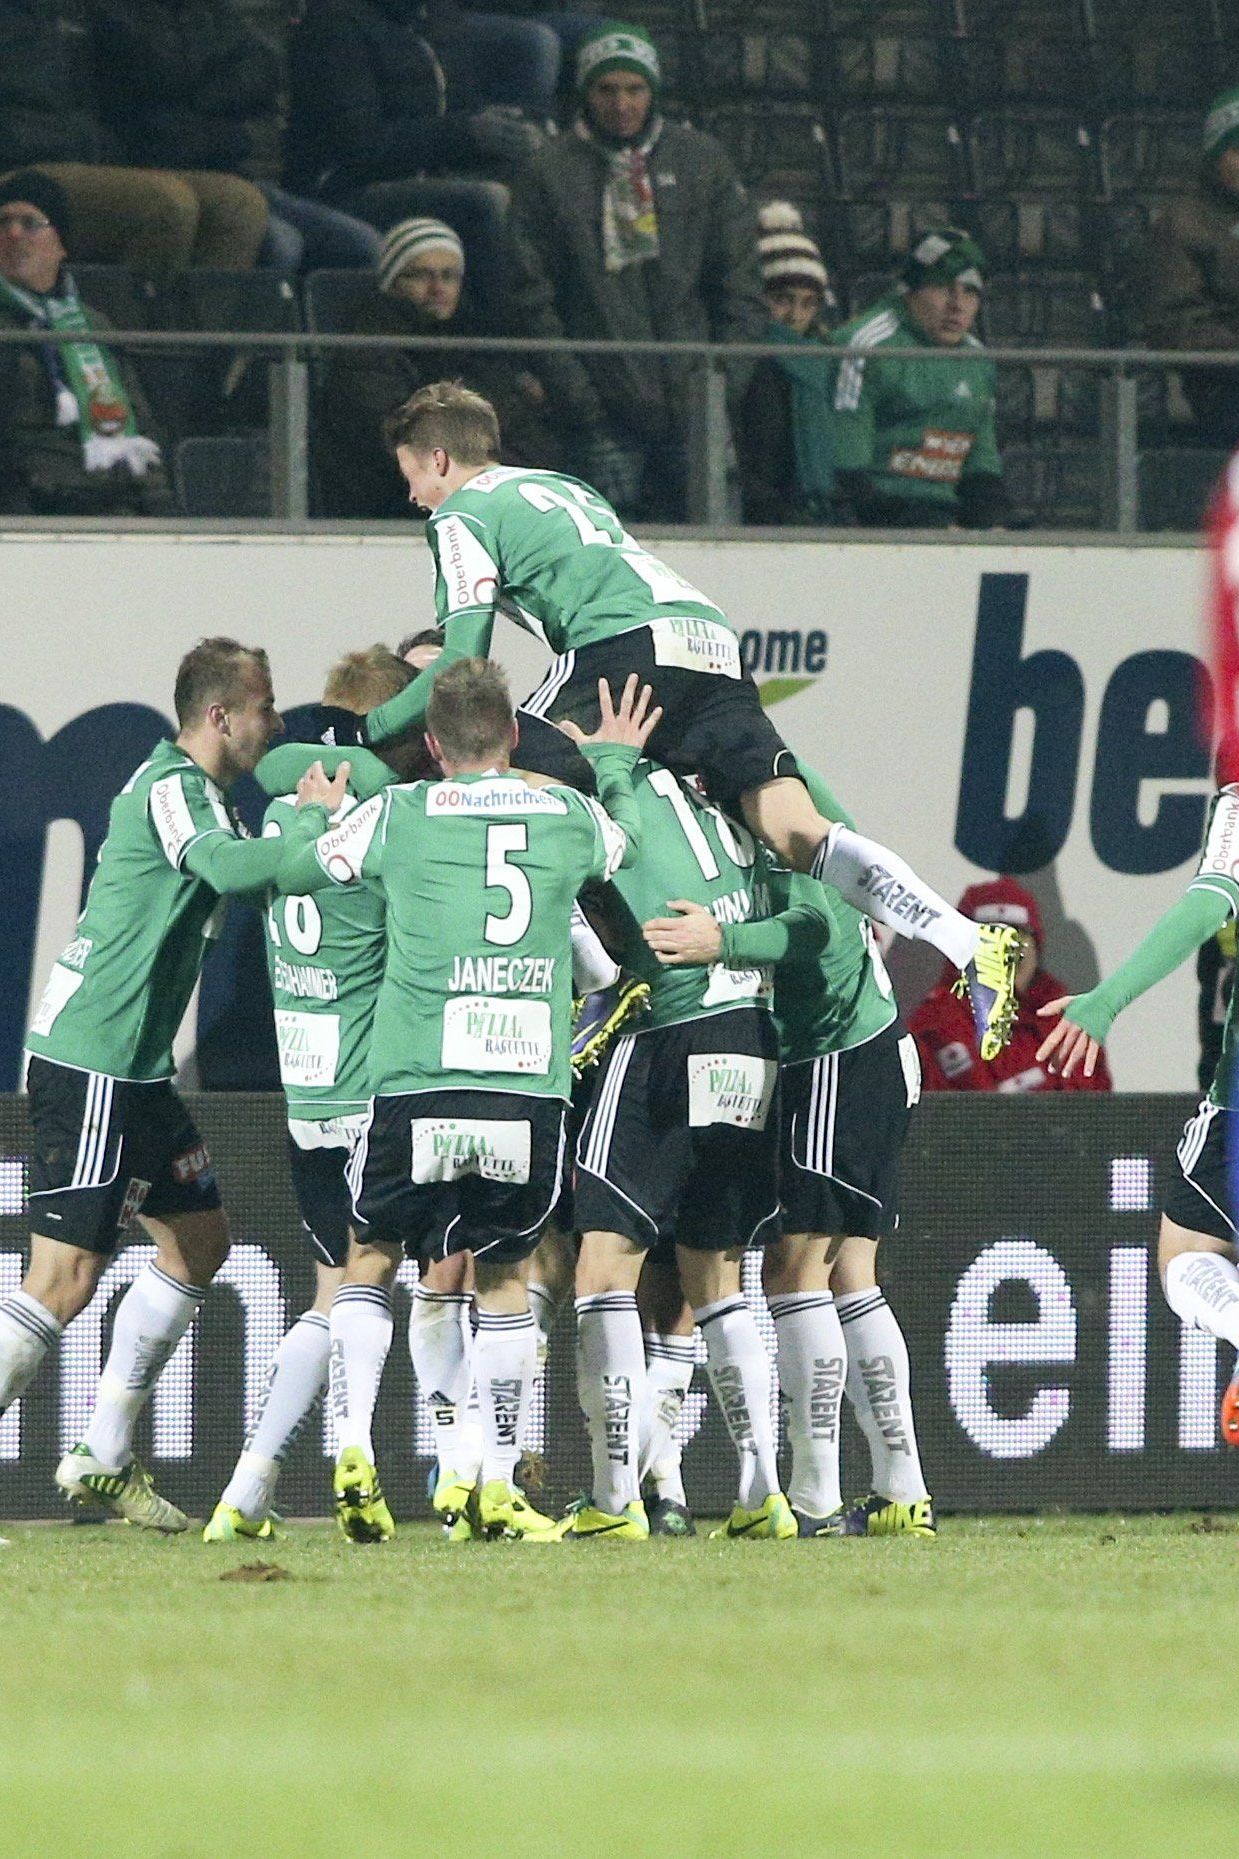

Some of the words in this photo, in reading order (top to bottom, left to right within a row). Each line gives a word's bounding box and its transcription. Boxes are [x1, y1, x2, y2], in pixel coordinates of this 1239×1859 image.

[447, 524, 471, 605] Oberbank
[953, 573, 1216, 875] be
[156, 784, 184, 848] Oberbank
[320, 802, 378, 857] Oberbank
[1213, 802, 1239, 871] Oberbank
[484, 822, 533, 946] 5
[447, 956, 556, 997] JANECZEK
[435, 1408, 456, 1427] 5
[490, 1377, 523, 1447] STARENT
[603, 1374, 631, 1466] STARENT
[810, 1356, 844, 1444] STARENT
[857, 1355, 911, 1456] STARENT
